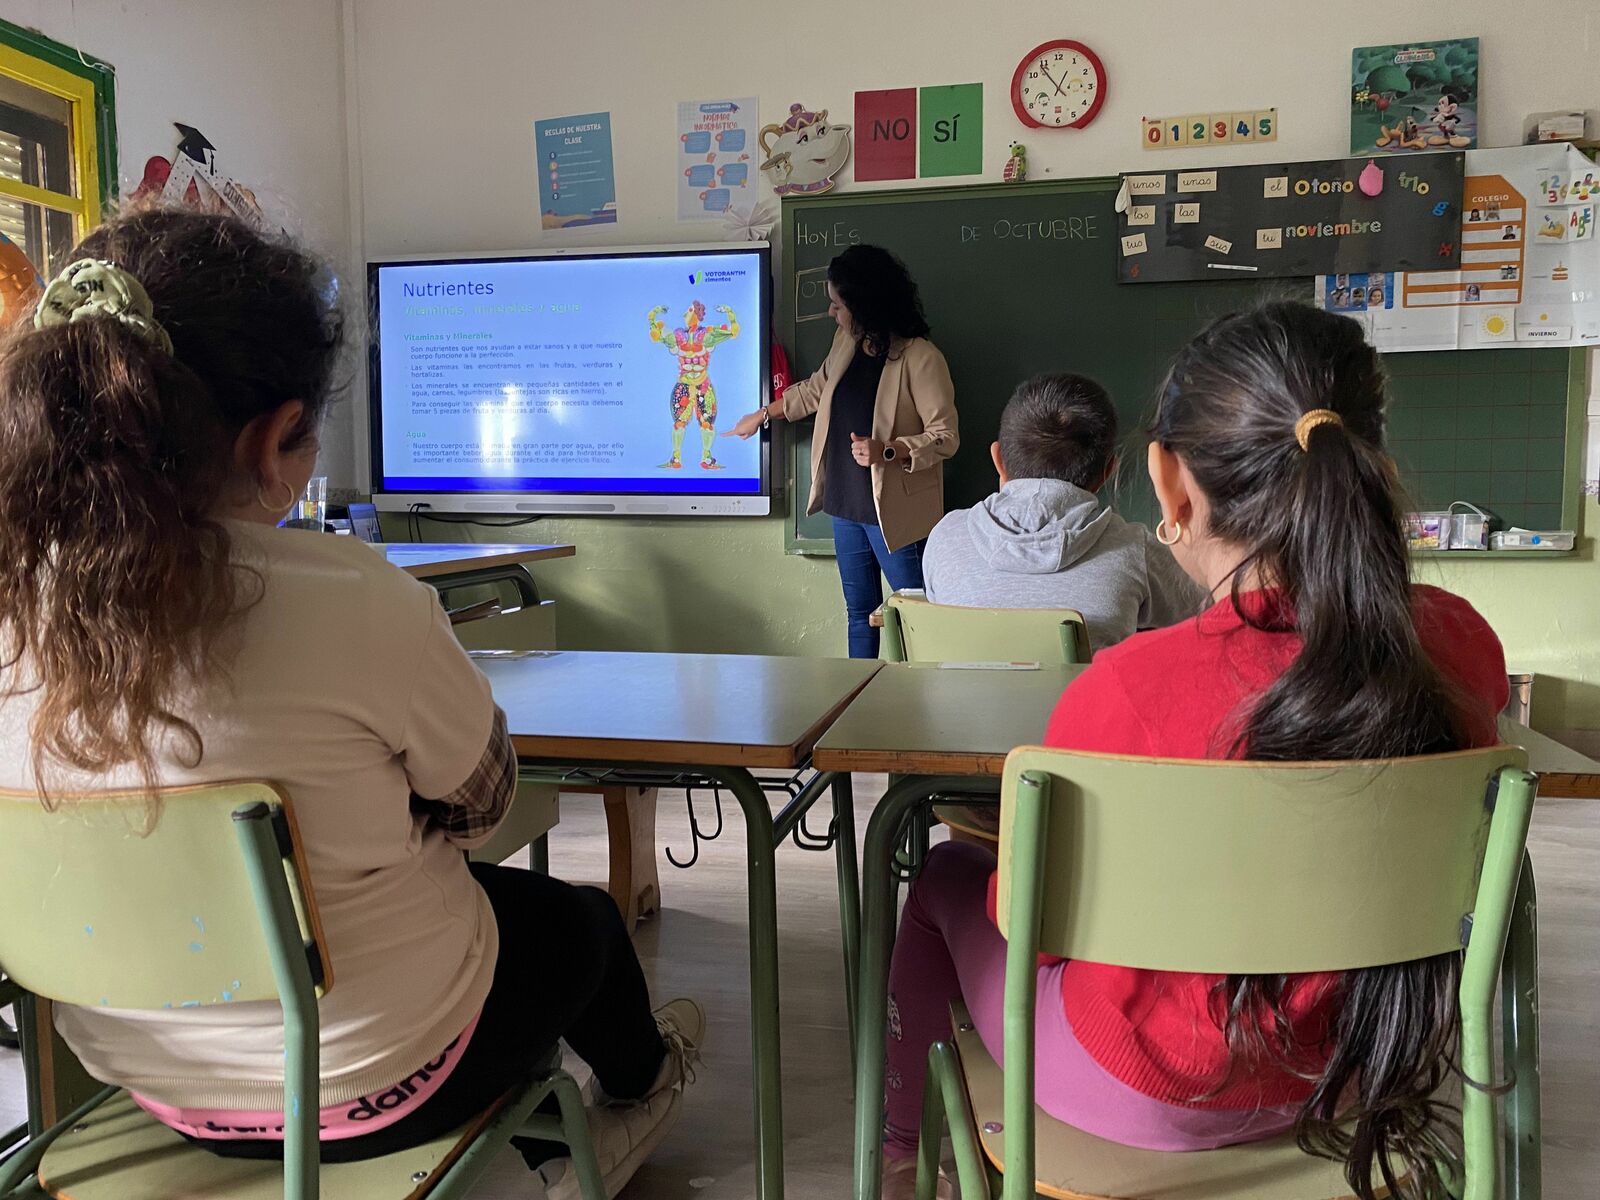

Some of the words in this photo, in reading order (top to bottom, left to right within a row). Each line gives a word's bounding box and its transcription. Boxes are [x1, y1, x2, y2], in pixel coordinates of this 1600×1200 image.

[544, 128, 566, 136] REGLAS
[576, 123, 601, 133] NUESTRA
[873, 118, 910, 141] NO
[934, 114, 960, 142] SÍ
[1148, 127, 1161, 143] 0
[1171, 125, 1179, 141] 1
[1193, 123, 1205, 139] 2
[1214, 121, 1226, 138] 3
[1237, 121, 1249, 136] 4
[1259, 119, 1271, 135] 5
[564, 136, 582, 144] CLASE
[1132, 180, 1160, 189] unos
[1182, 178, 1212, 186] unas
[1270, 179, 1282, 191] el
[1541, 180, 1547, 194] 1
[1551, 175, 1560, 188] 2
[1472, 194, 1509, 202] COLEGIO
[1548, 190, 1557, 202] 3
[1134, 208, 1149, 220] los
[1179, 205, 1195, 217] las
[961, 225, 980, 242] DE
[993, 216, 1099, 240] OCTUBRE
[1570, 212, 1577, 227] A
[1577, 216, 1586, 238] B
[1584, 208, 1591, 223] E
[1262, 234, 1275, 242] tu
[1286, 218, 1382, 238] noviembre
[1126, 240, 1143, 249] tus
[1210, 240, 1228, 251] sus
[403, 281, 494, 297] Nutrientes
